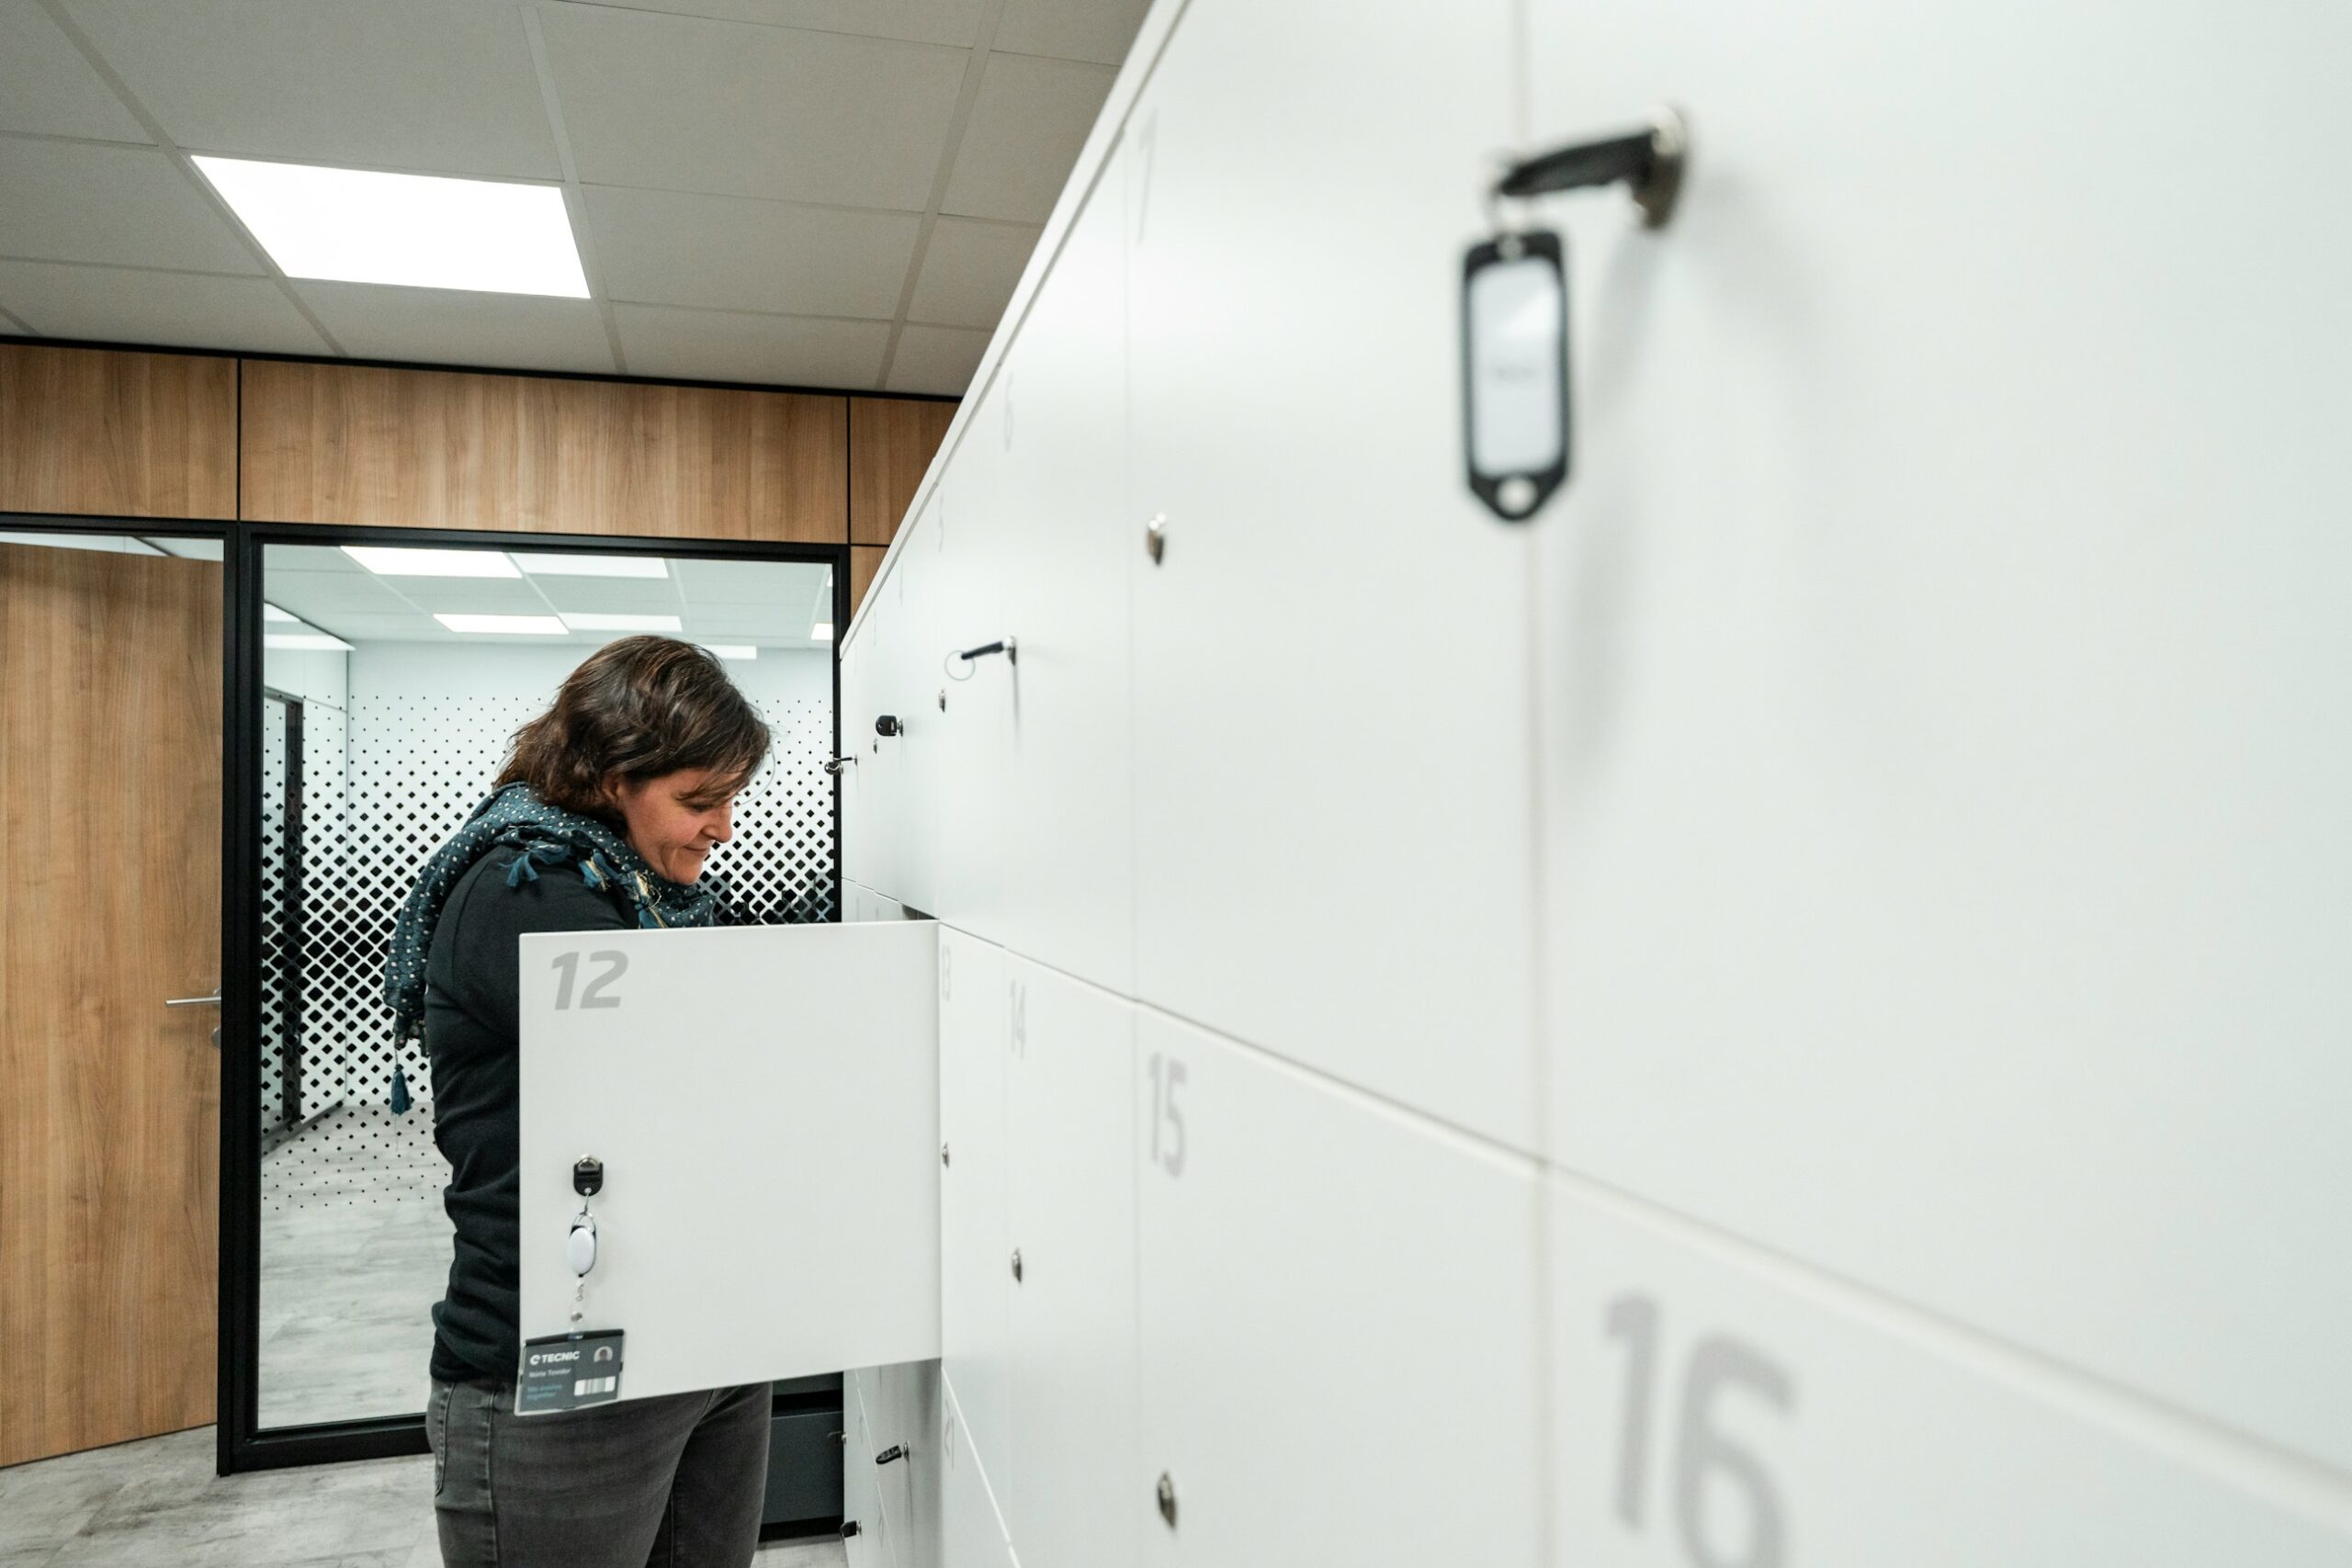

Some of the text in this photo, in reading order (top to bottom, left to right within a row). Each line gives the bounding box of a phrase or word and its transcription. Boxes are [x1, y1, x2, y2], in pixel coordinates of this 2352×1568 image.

[550, 950, 629, 1010] 12
[1010, 978, 1027, 1061] 14
[1148, 1052, 1188, 1179] 15
[541, 1350, 581, 1364] TECNIC
[1604, 1293, 1795, 1568] 16
